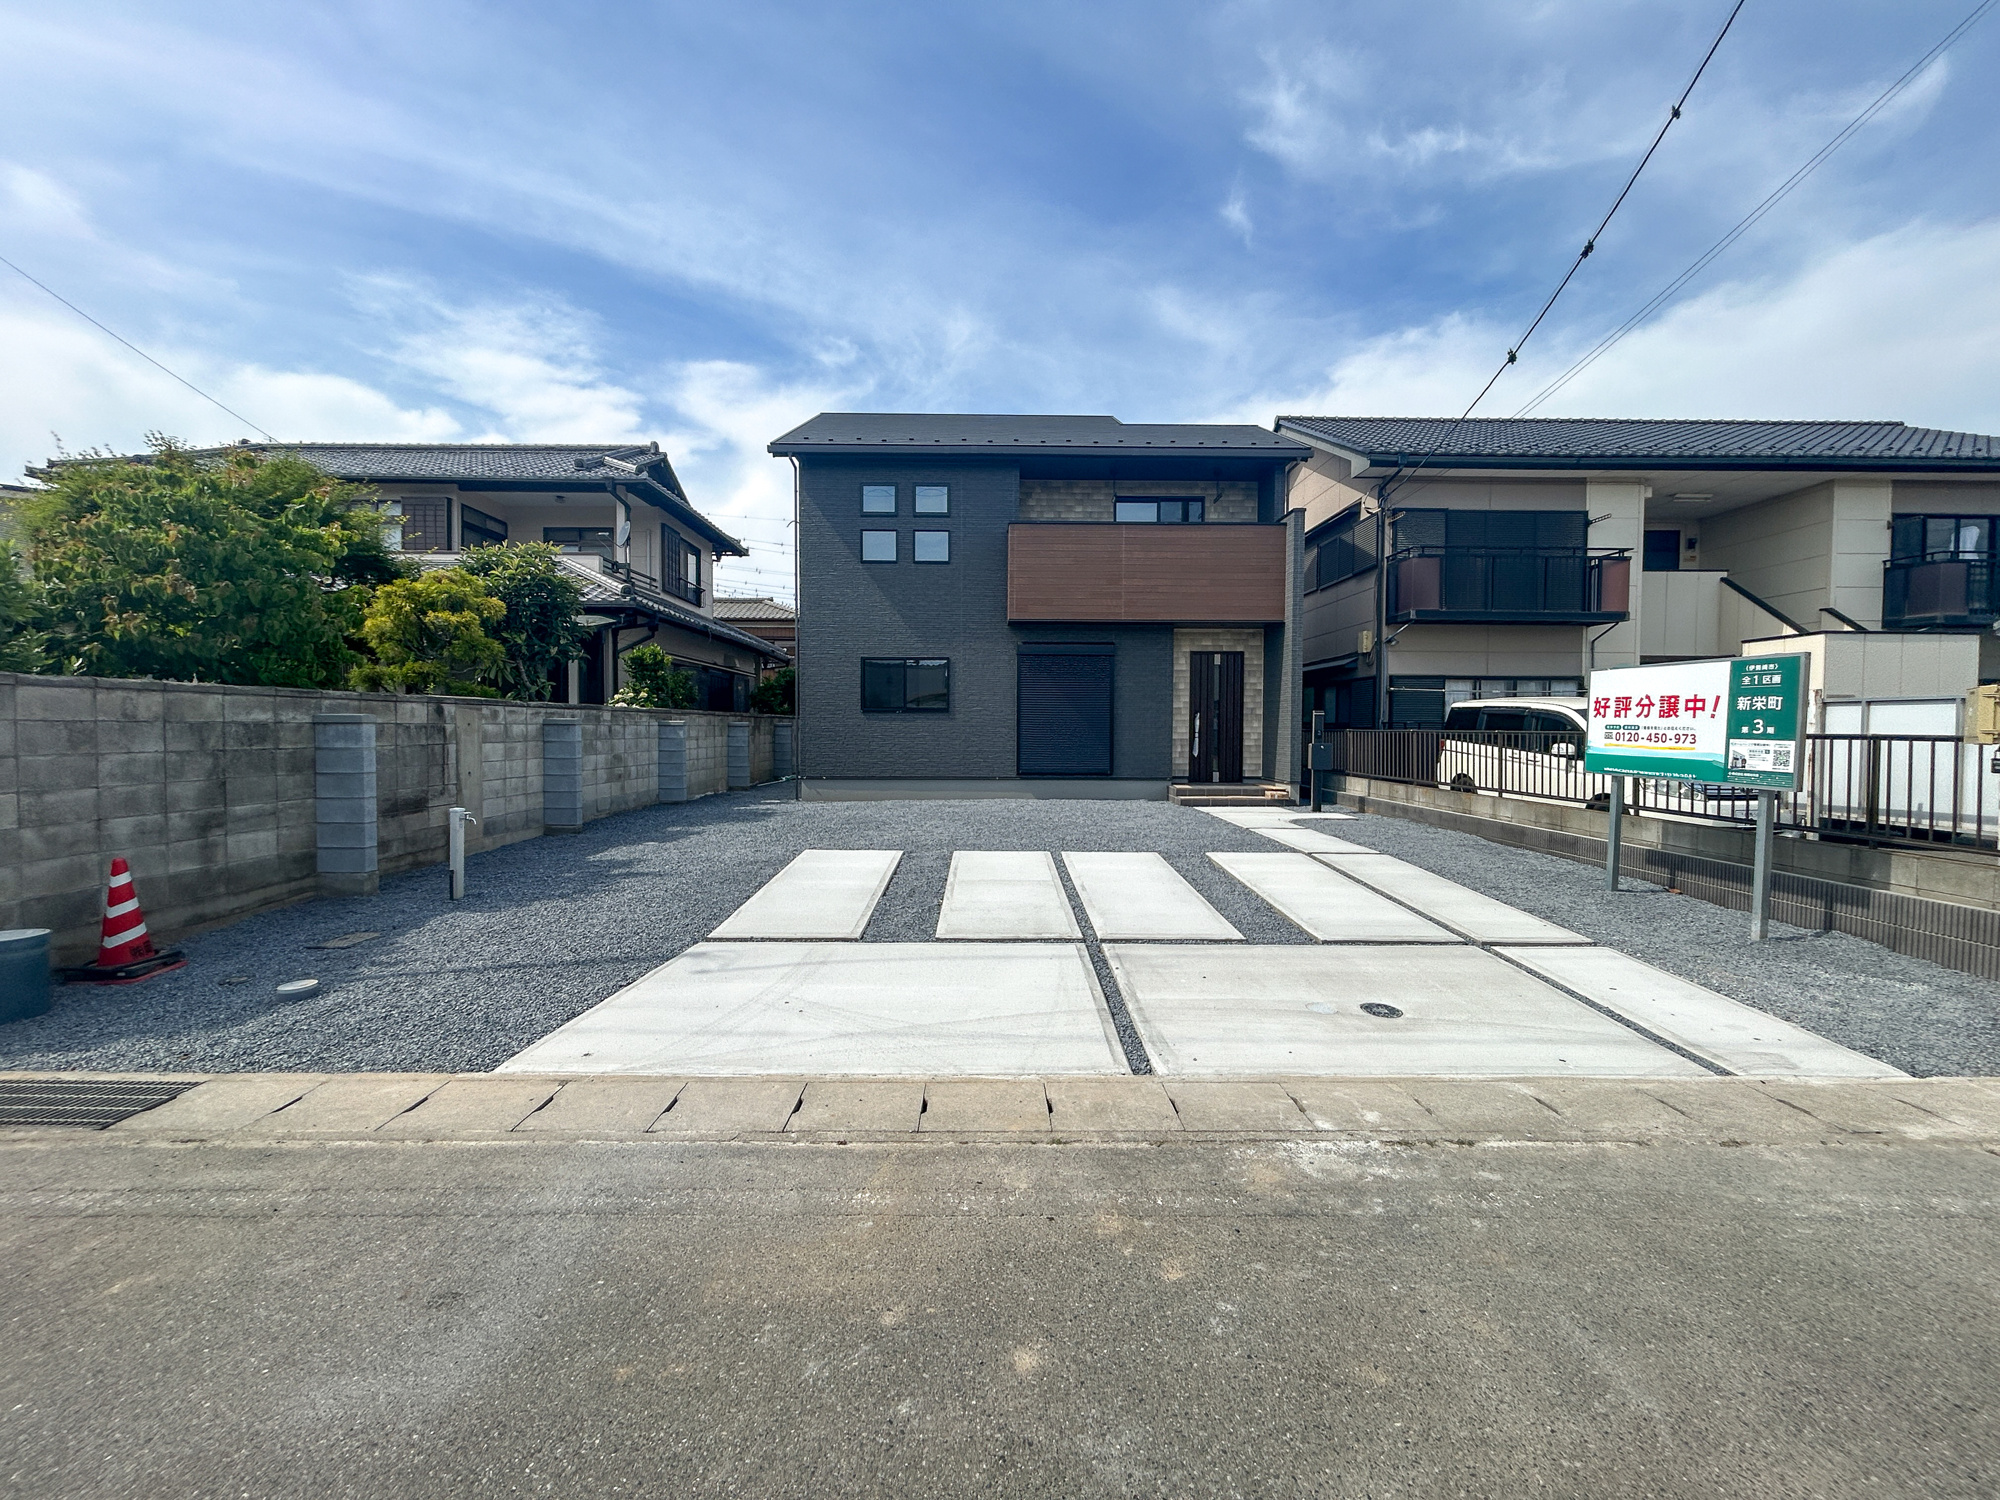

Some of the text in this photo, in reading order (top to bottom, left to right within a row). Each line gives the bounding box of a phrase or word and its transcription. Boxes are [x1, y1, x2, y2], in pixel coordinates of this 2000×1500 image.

[1594, 694, 1720, 718] 好評分譲中!
[1736, 696, 1783, 710] 新栄町
[1615, 732, 1696, 744] 0120-450-973
